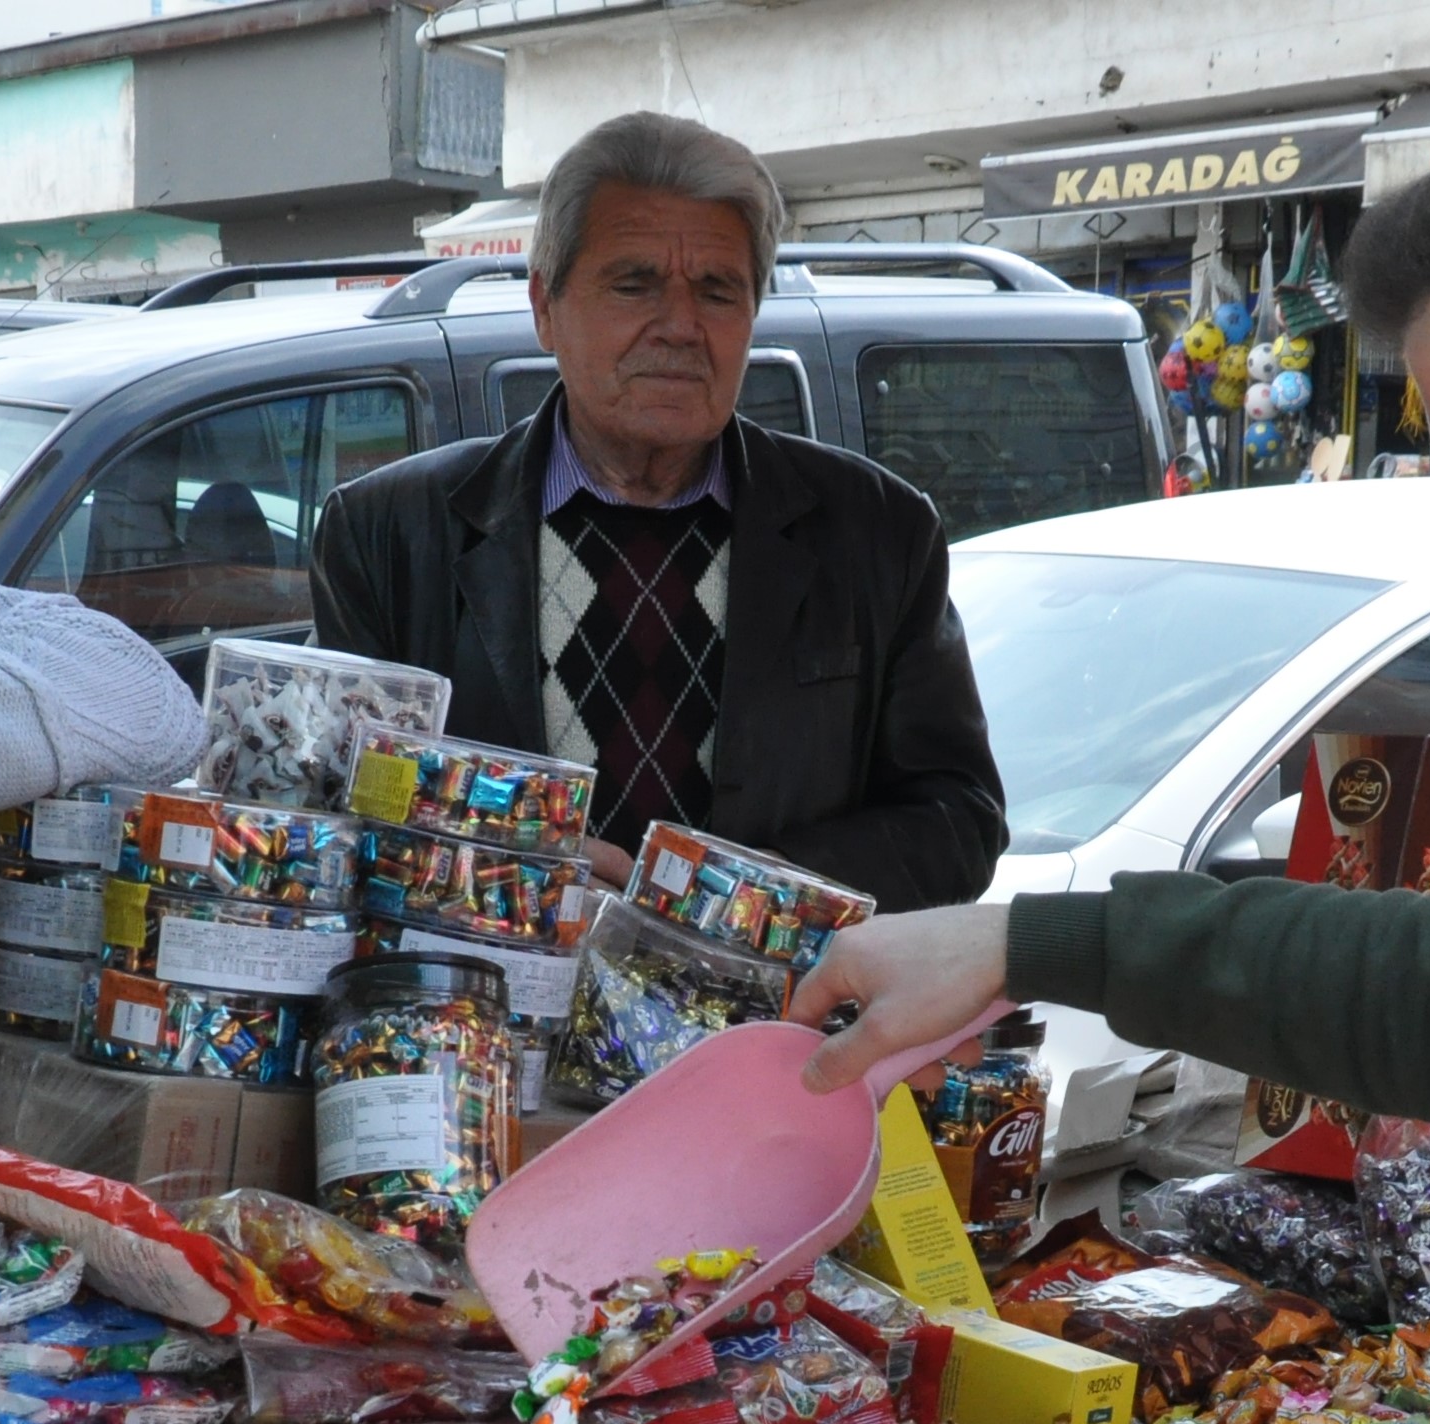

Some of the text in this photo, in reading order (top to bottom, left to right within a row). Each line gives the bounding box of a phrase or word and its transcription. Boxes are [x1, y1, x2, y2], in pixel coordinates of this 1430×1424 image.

[1052, 137, 1301, 206] KARADAĞ
[1336, 777, 1383, 797] Novien
[989, 1112, 1041, 1158] Gift
